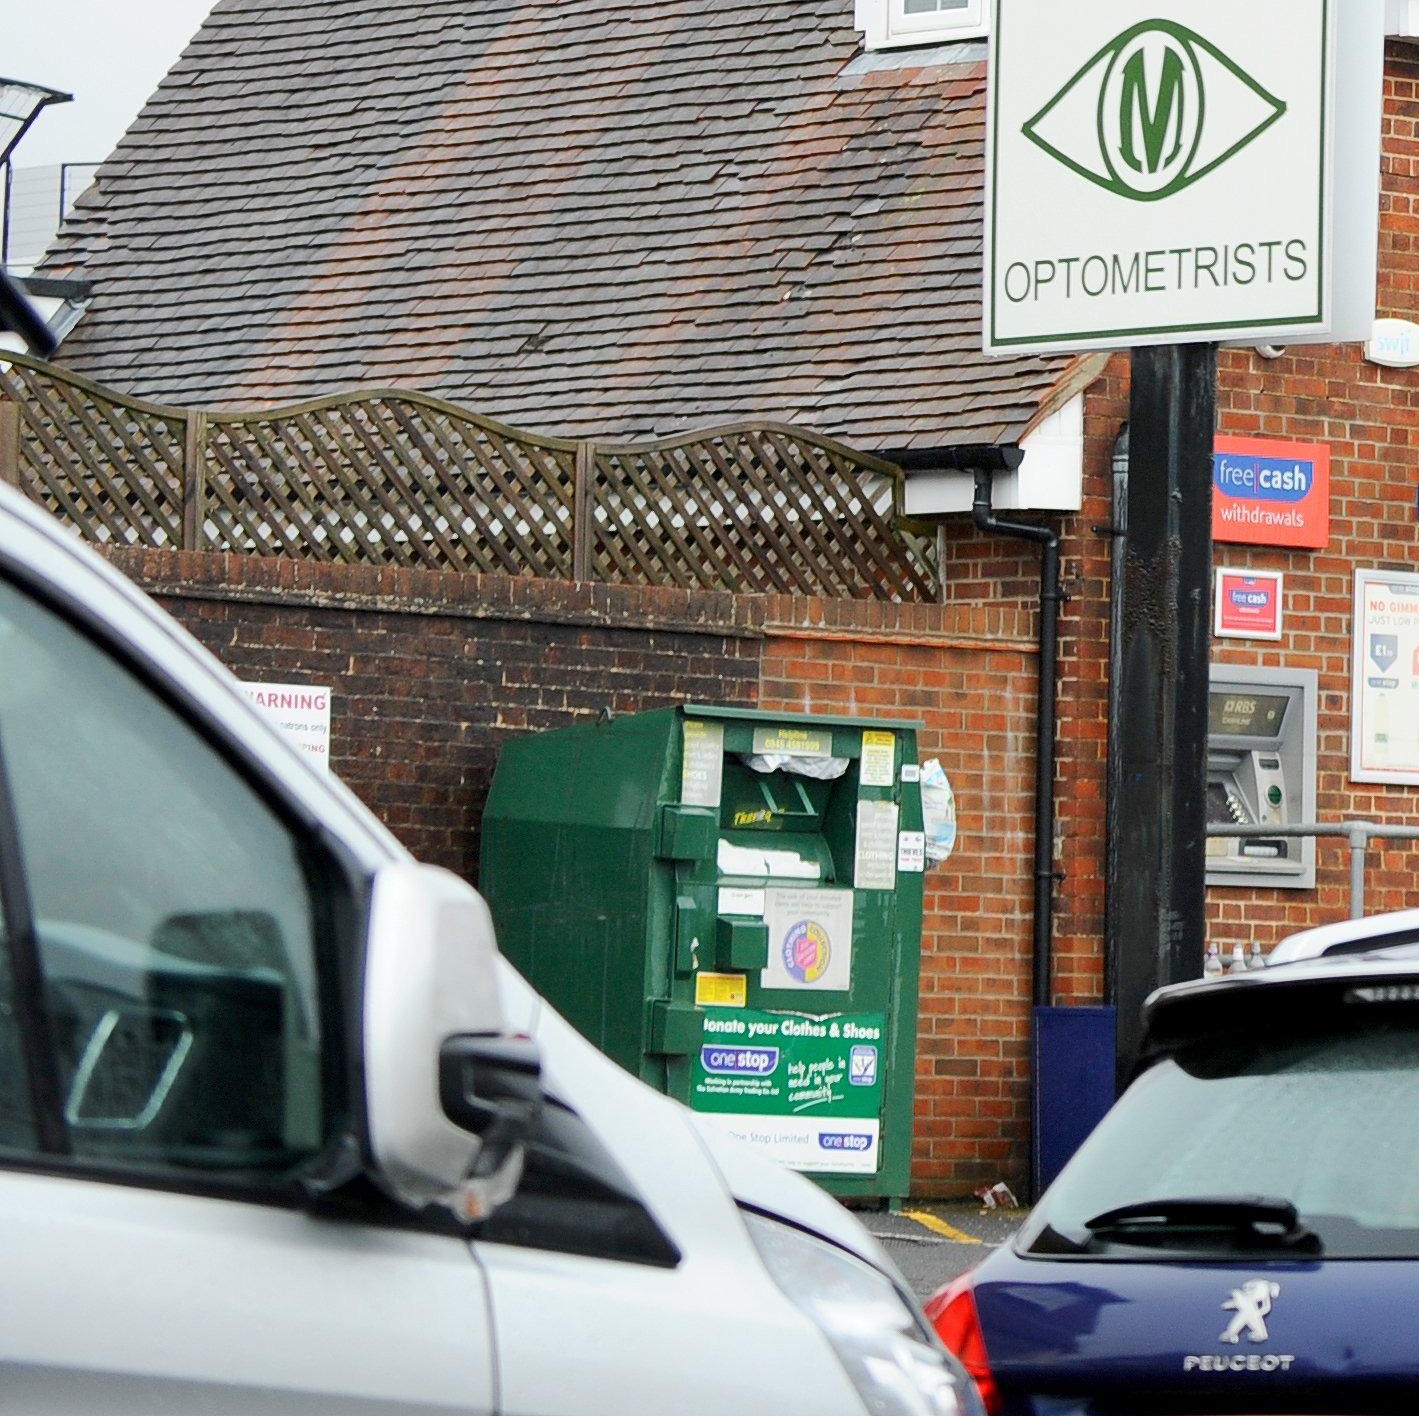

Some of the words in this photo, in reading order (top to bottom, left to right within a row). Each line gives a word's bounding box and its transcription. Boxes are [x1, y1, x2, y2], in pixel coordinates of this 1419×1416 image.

[1004, 239, 1307, 303] OPTOMETRISTS
[1220, 459, 1254, 486] free
[1259, 464, 1306, 492] cash
[1220, 503, 1304, 528] withdrawals
[1247, 590, 1267, 604] cash
[1370, 601, 1385, 611] NO
[1368, 615, 1390, 625] JUST
[1393, 617, 1411, 625] LOW
[246, 690, 327, 710] ARNING
[1234, 700, 1256, 714] RBS
[748, 1021, 779, 1038] your
[781, 1019, 827, 1038] Clothes
[829, 1023, 841, 1039] &
[843, 1023, 881, 1040] Shoes
[711, 1053, 735, 1068] one
[737, 1051, 770, 1073] stop
[788, 1060, 805, 1081] help
[808, 1058, 835, 1079] people
[750, 1132, 772, 1145] Stop
[774, 1133, 809, 1144] Limited
[823, 1135, 843, 1148] one
[843, 1135, 868, 1151] stop
[1184, 1355, 1295, 1372] PEUGEOT
